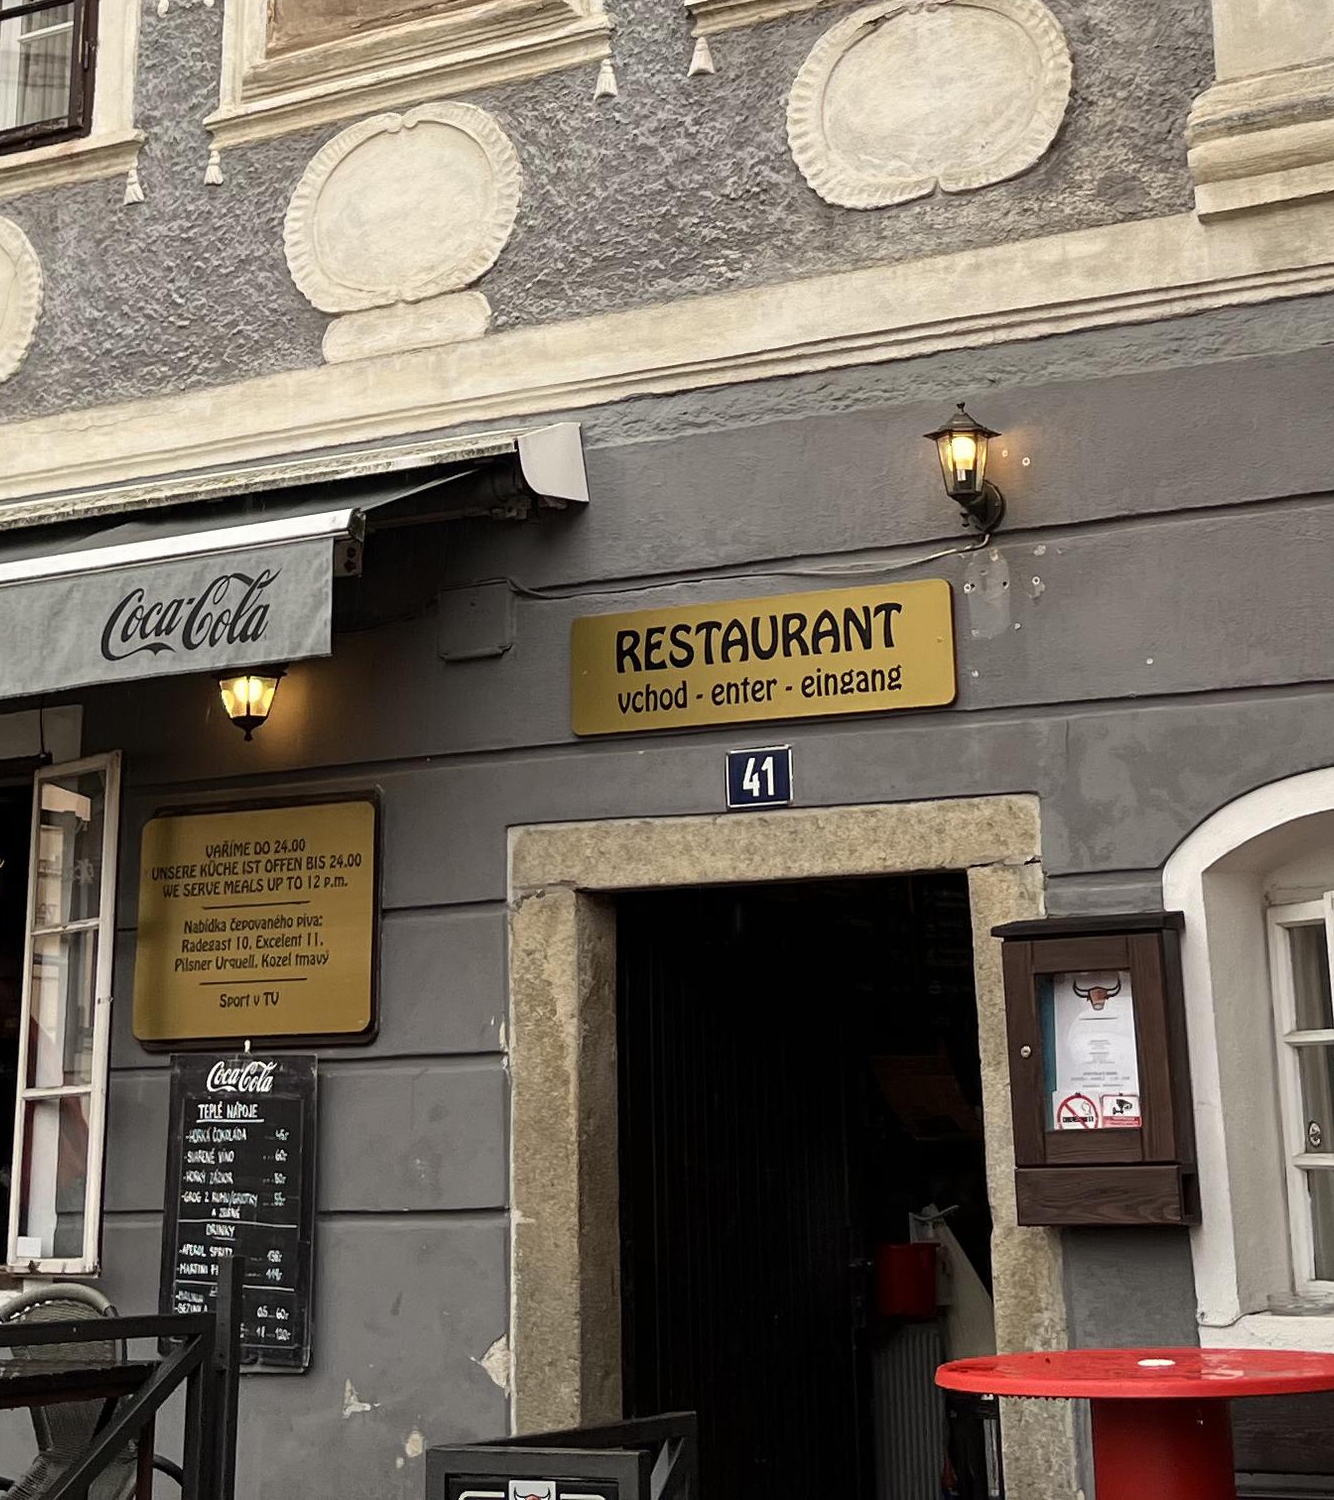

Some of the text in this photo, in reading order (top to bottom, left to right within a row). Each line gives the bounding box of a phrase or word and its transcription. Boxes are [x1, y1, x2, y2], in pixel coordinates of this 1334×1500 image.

[100, 568, 283, 661] Coca-Cola
[616, 602, 903, 674] RESTAURANT
[618, 680, 688, 714] vchod
[711, 674, 777, 706] enter
[801, 664, 903, 698] eingang
[743, 756, 775, 797] 41
[205, 838, 306, 859] VAŘÍME DO 24.00
[151, 853, 362, 881] UNSERE KÜCHE IST OFFEN BIS 24.00
[163, 874, 348, 898] WE SERVE MEALS UP TO 12 p.m.
[183, 913, 323, 935] Nabídka čepovaného piva:
[181, 938, 231, 953] Radegast
[255, 933, 302, 949] Excelent
[174, 957, 212, 972] Pilsner
[261, 952, 291, 967] Kozel
[294, 950, 329, 966] tmavý
[219, 994, 250, 1008] Sport
[263, 991, 280, 1006] TV
[206, 1060, 278, 1092] Coca-Cola
[198, 1101, 259, 1119] TEPLÉ NÁPOJE
[206, 1223, 236, 1237] DRINKY
